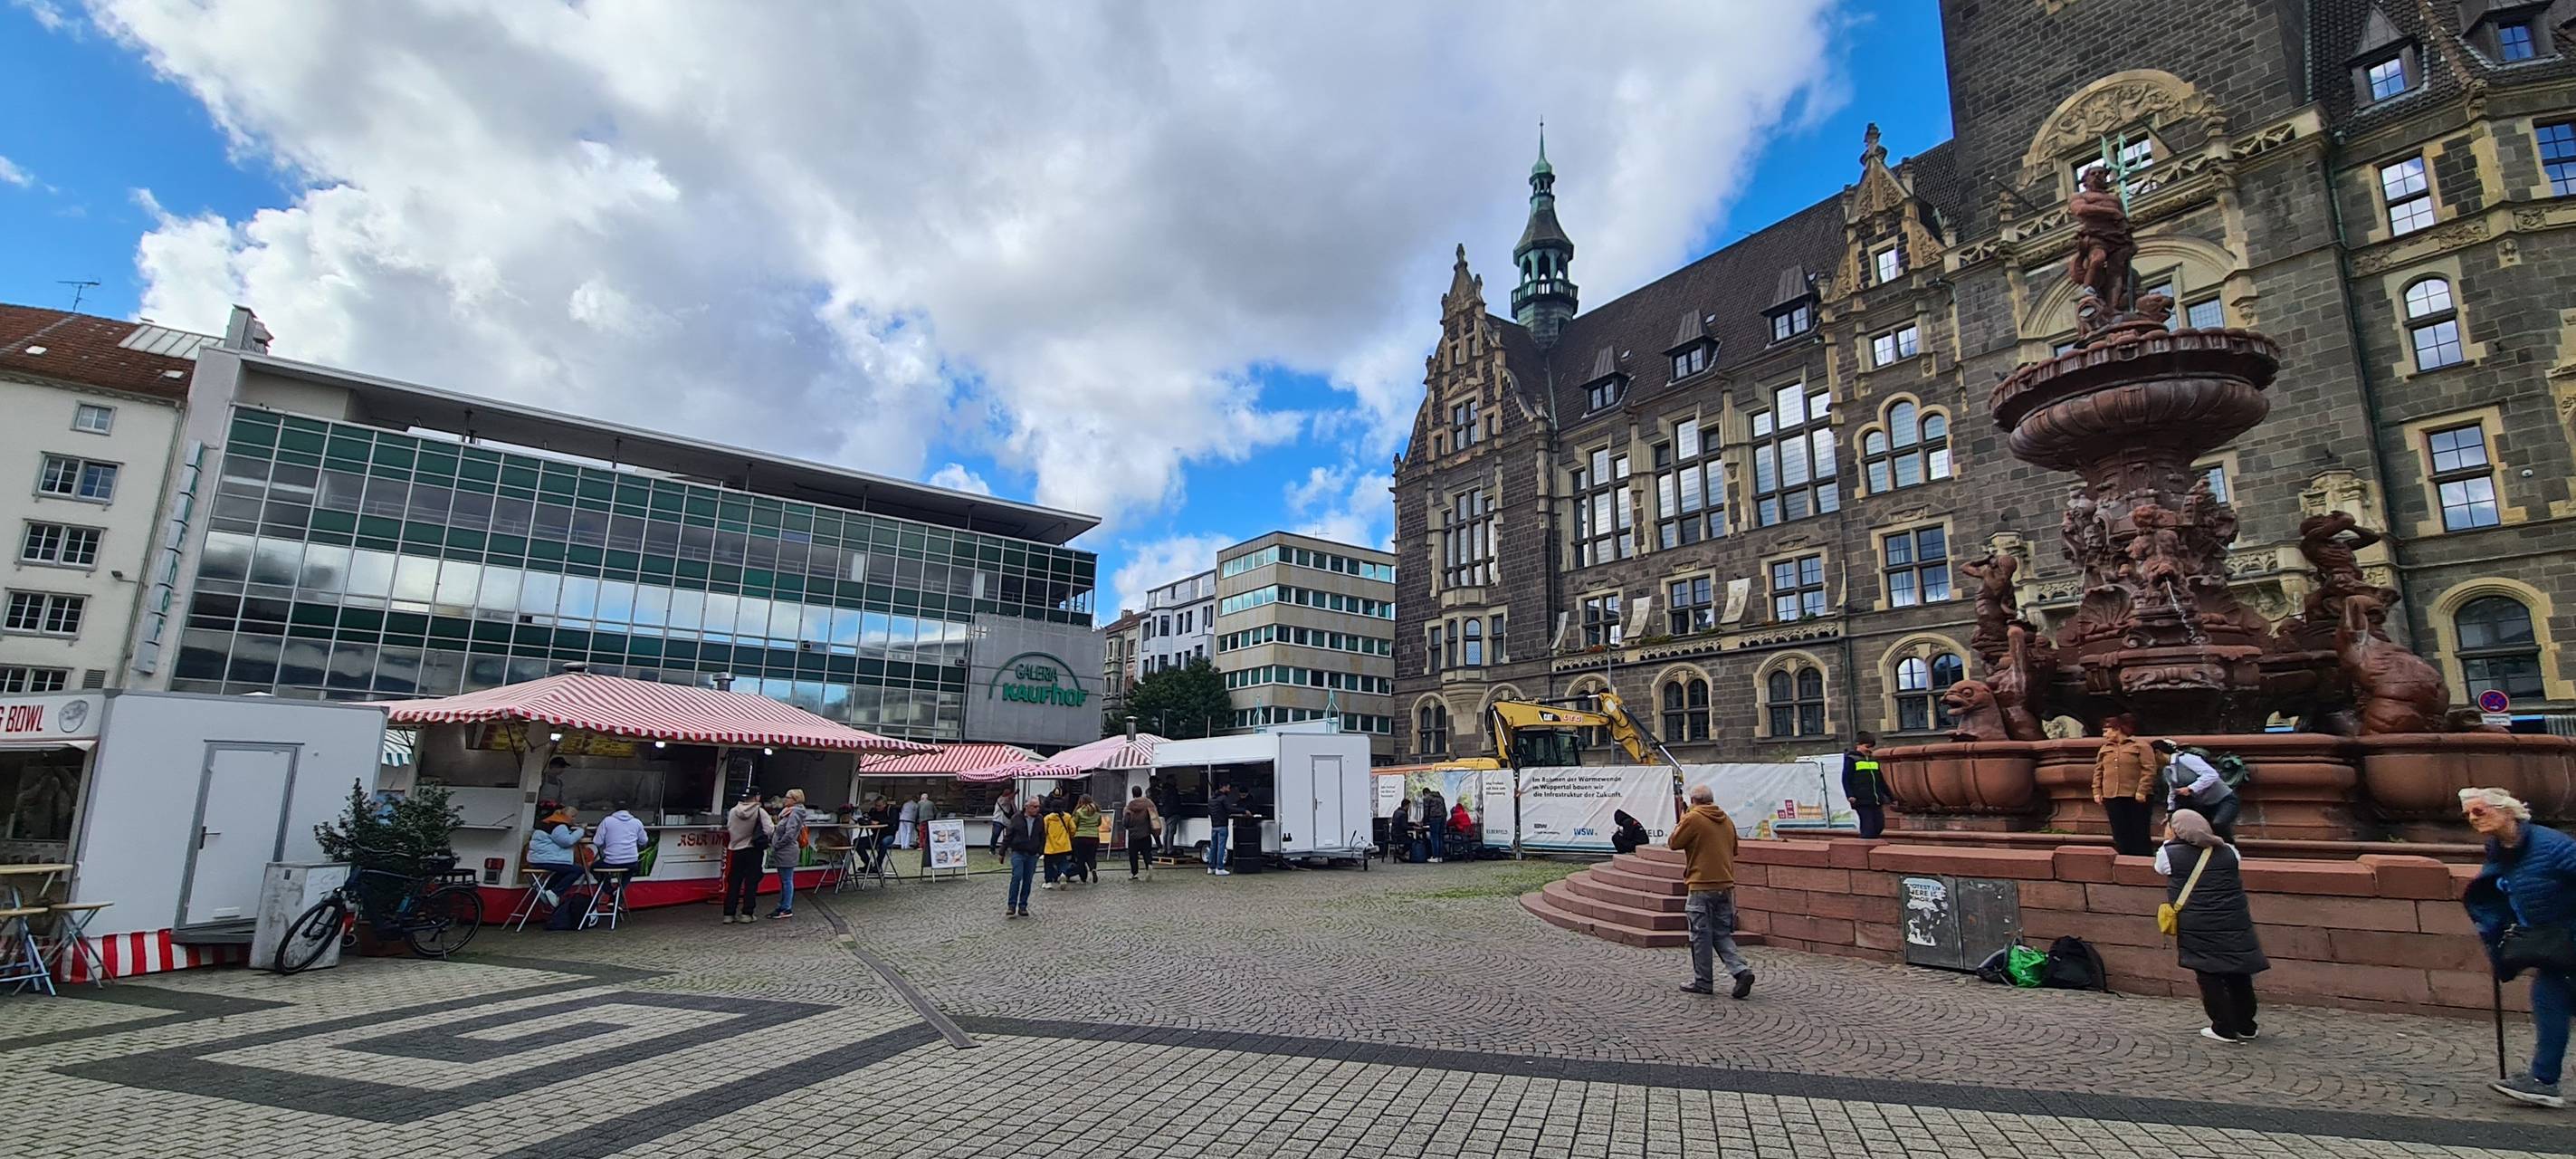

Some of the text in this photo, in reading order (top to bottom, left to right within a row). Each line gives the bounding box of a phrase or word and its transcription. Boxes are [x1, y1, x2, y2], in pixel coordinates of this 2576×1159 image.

[1015, 664, 1058, 682] GALERIA
[5, 704, 44, 733] BOWL
[677, 833, 708, 847] ASIA
